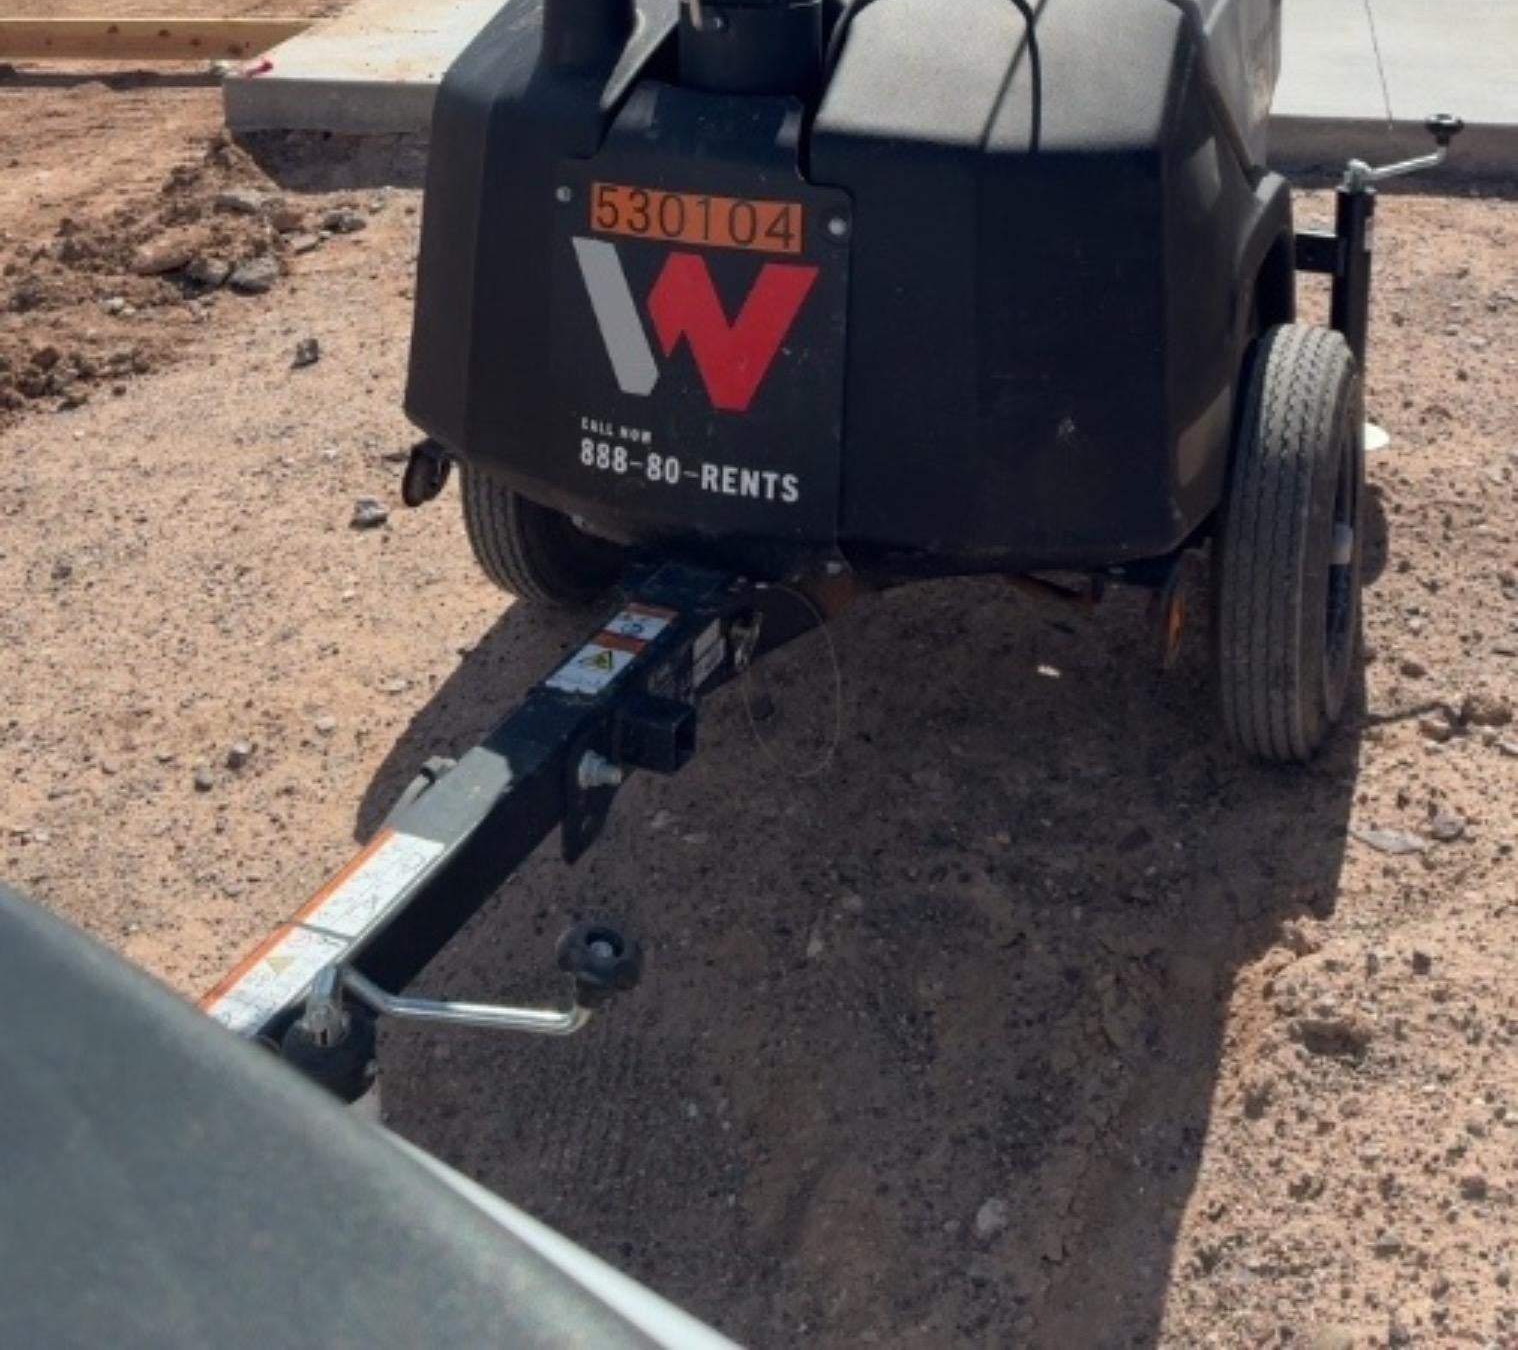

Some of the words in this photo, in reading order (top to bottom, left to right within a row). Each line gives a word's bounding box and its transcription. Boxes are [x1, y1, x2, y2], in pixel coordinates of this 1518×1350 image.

[594, 186, 796, 249] 530104
[581, 416, 613, 437] CALL
[620, 425, 652, 444] NOW
[580, 437, 800, 502] 888-80-RENTS
